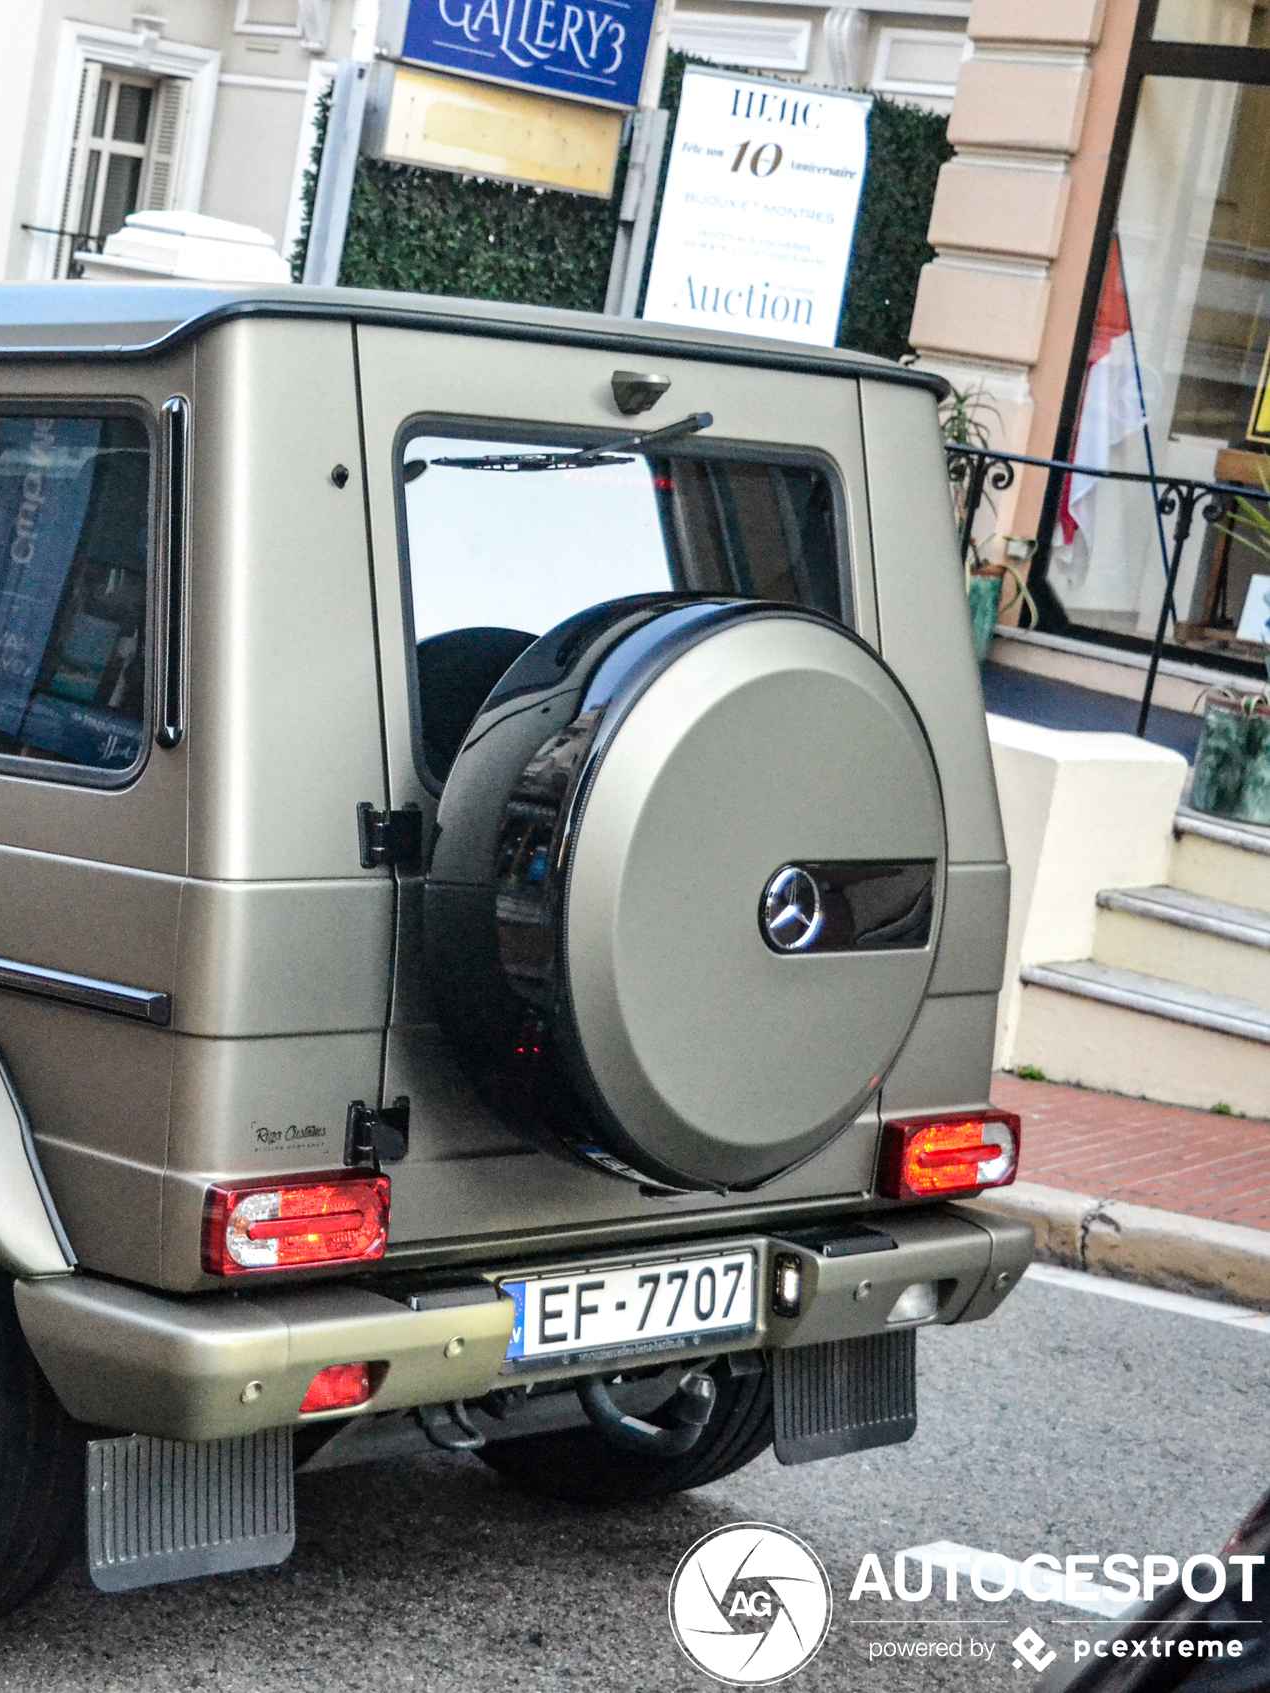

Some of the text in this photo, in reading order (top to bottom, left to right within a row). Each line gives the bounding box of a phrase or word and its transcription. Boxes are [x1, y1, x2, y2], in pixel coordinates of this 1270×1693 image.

[684, 191, 836, 225] BIJOUX ET MONTRES
[672, 274, 814, 326] Auction
[256, 1127, 283, 1145] Riga
[538, 1261, 745, 1345] EF-7707
